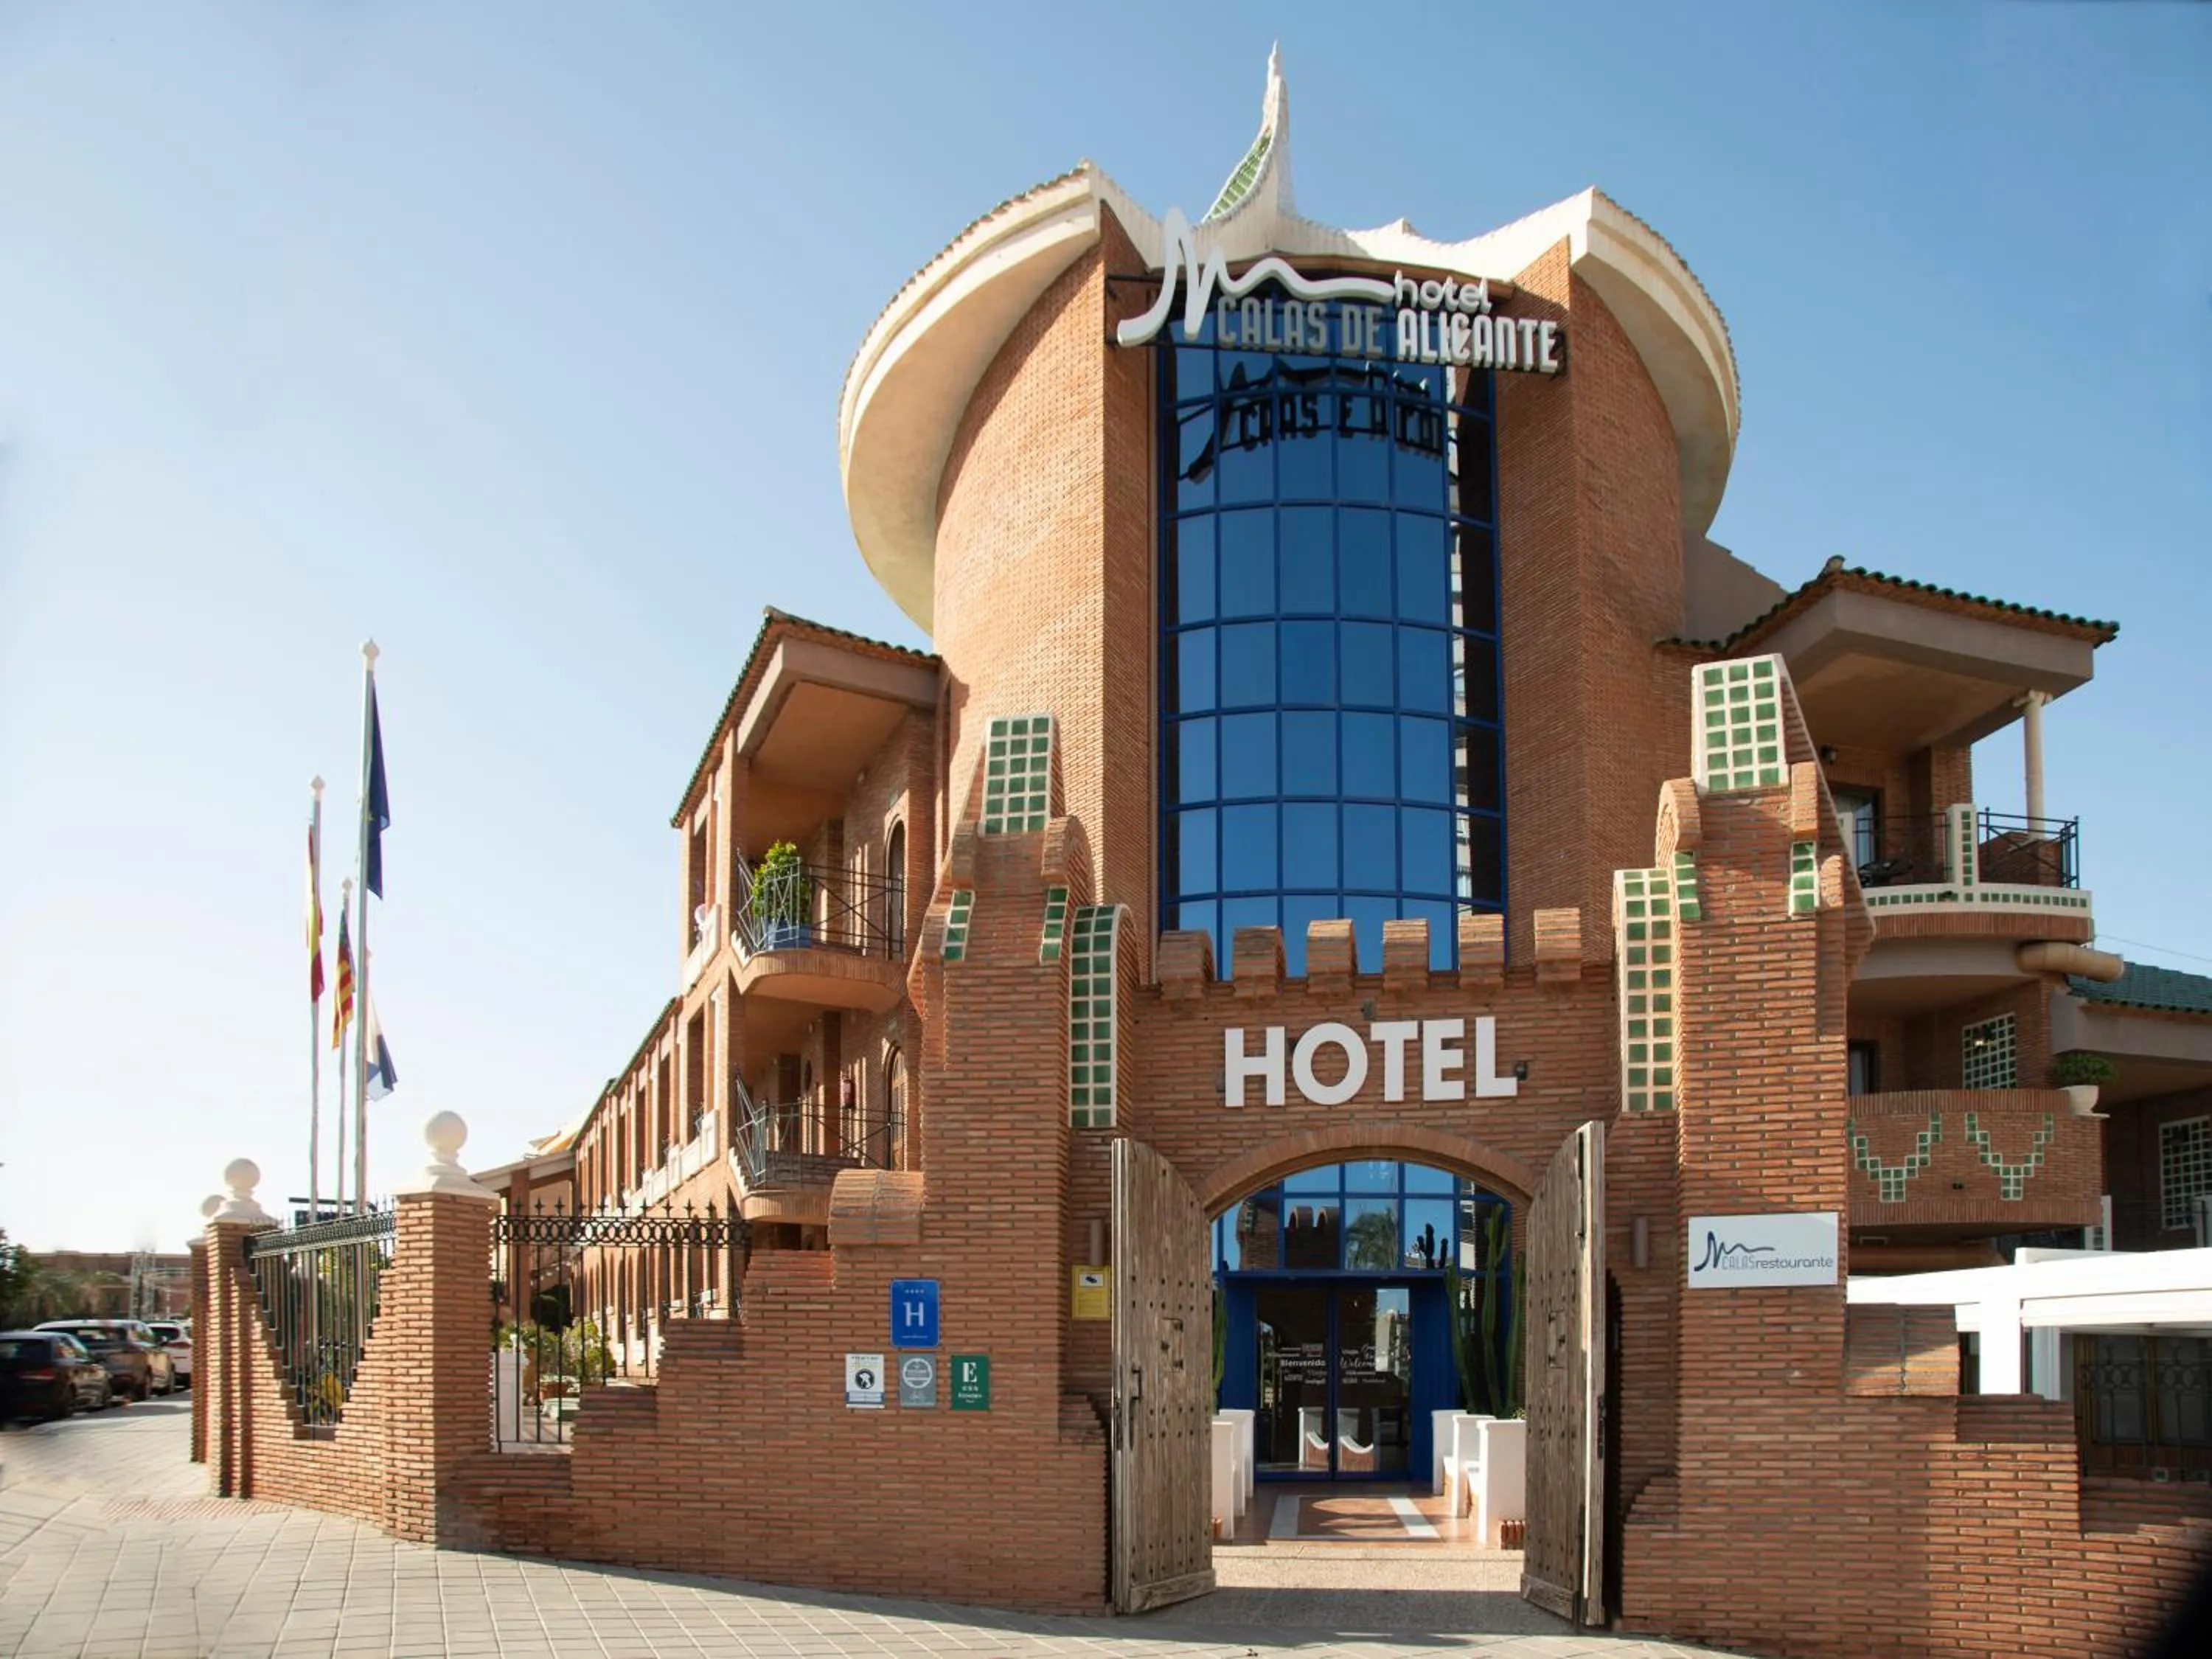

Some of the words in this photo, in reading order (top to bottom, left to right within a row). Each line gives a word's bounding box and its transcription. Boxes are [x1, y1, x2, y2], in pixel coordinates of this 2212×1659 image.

[1394, 269, 1492, 314] hotel
[1217, 296, 1326, 353] CALAS
[1341, 303, 1383, 359] DE
[1397, 307, 1558, 372] ALICANTE
[1225, 1016, 1517, 1107] HOTEL
[1722, 1255, 1756, 1270] CALAS
[1756, 1256, 1834, 1270] restaurante
[903, 1301, 925, 1327] H
